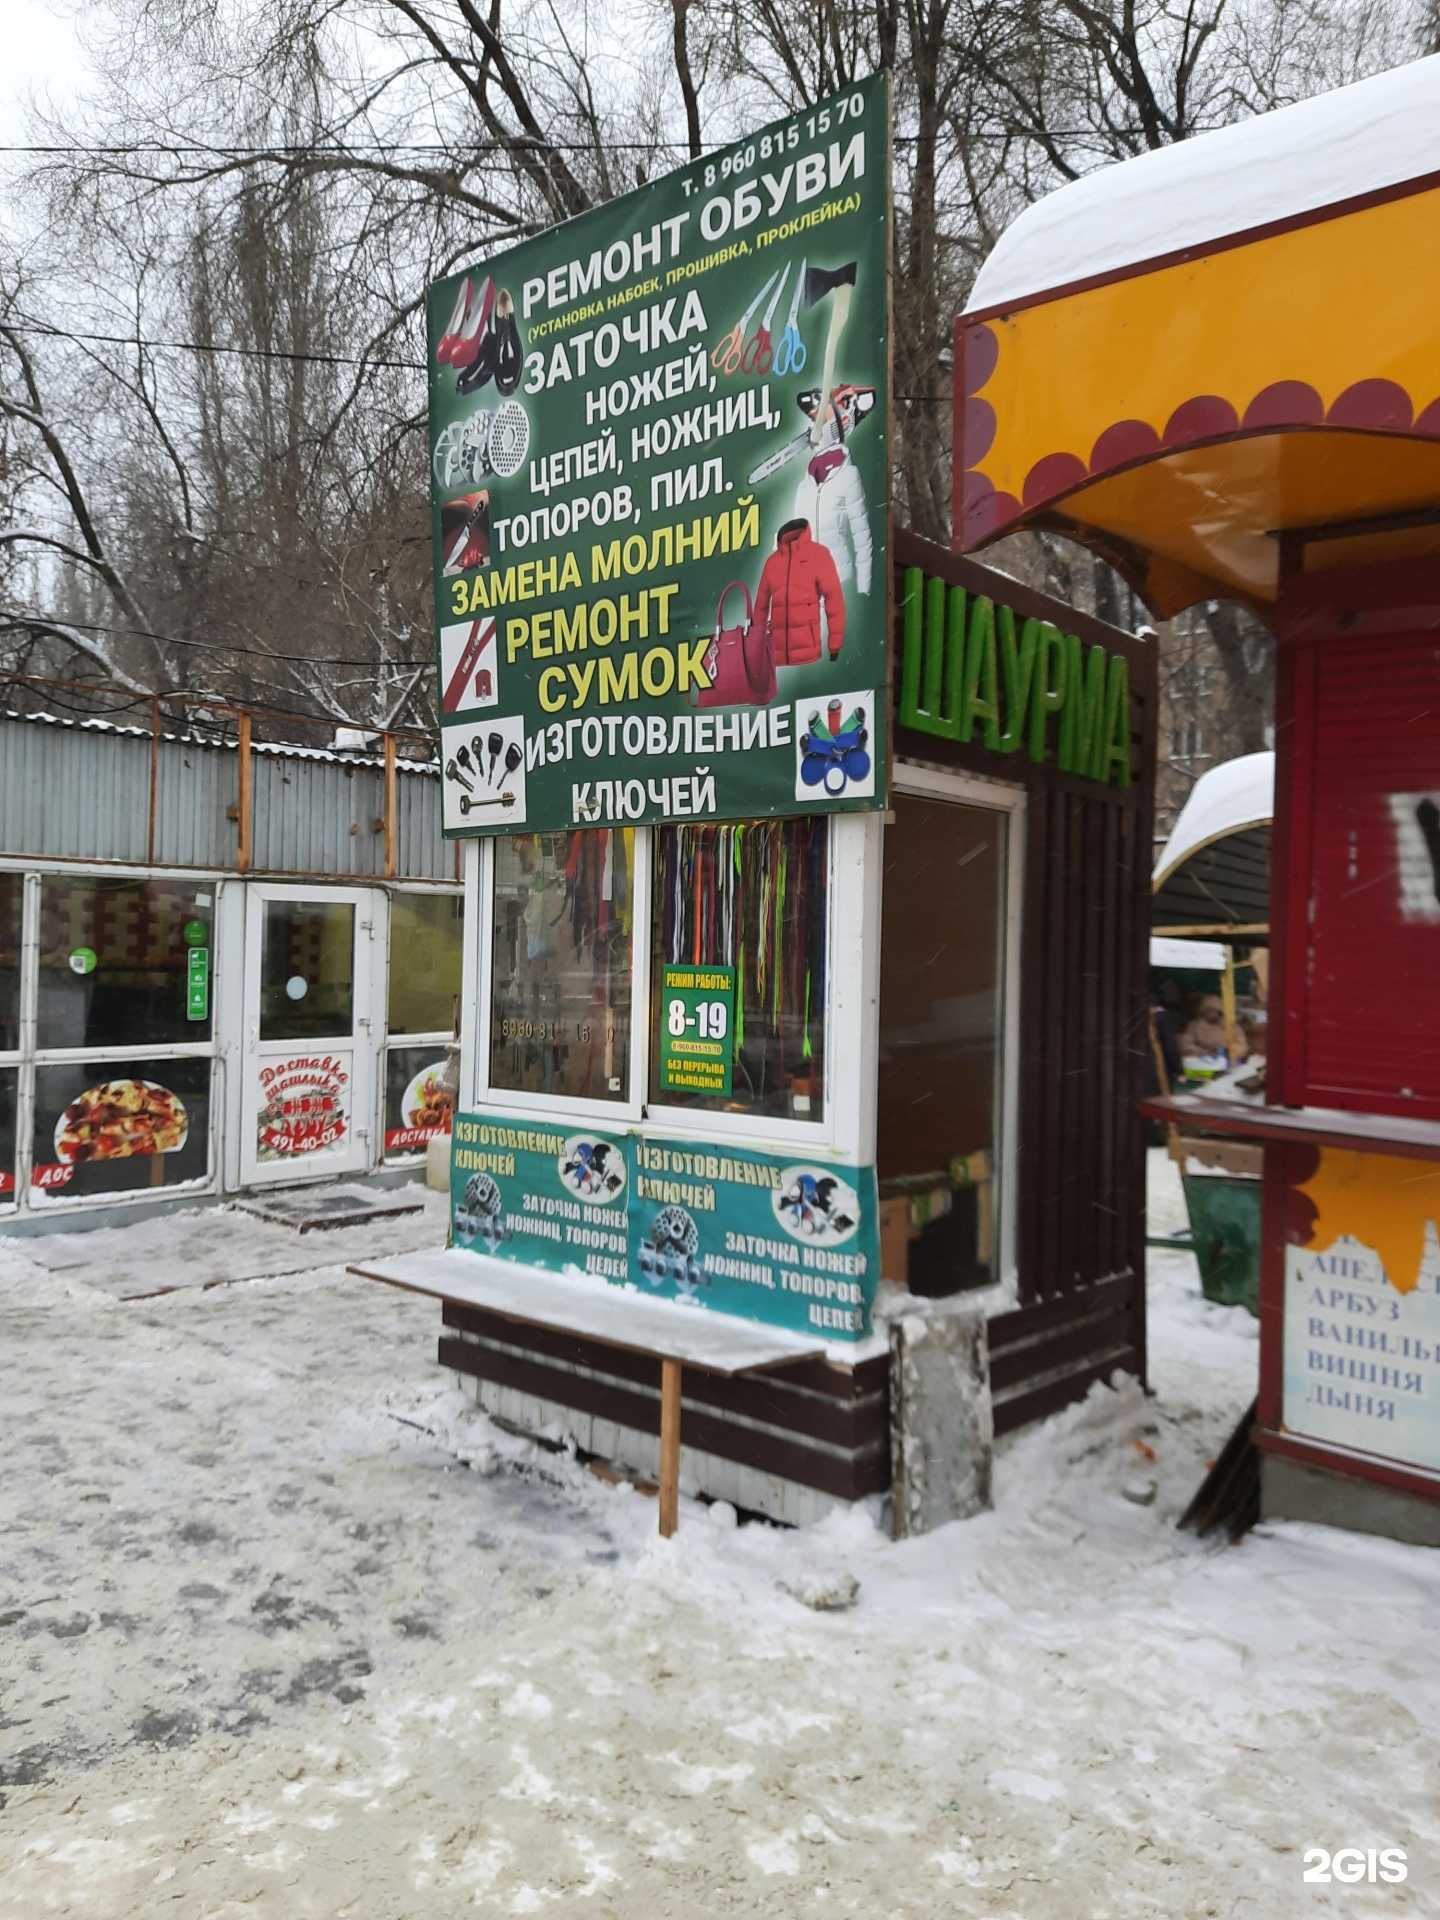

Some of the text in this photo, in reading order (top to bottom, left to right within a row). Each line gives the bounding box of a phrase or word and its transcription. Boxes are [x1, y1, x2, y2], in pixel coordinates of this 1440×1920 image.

[704, 164, 716, 187] 8
[721, 145, 756, 180] 960
[760, 124, 800, 159] 815
[806, 109, 831, 139] 15
[835, 92, 865, 125] 70
[521, 131, 866, 320] РЕМОНТ ОБУВИ
[527, 194, 862, 344] (УСТАНОВКА НАБОЕК, ПРОШИВКА, ПРОКЛЕЙКА)
[524, 289, 709, 395] ЗАТОЧКА
[584, 345, 718, 425] НОЖЕЙ,
[529, 384, 782, 496] ЦЕПЕЙ, НОЖНИЦ,
[493, 456, 734, 552] ТОПОРОВ, ПИЛ.
[451, 494, 760, 616] ЗАМЕНА МОЛНИЙ
[505, 583, 680, 664] РЕМОНТ
[538, 637, 713, 713] СУМОК
[899, 566, 1132, 790] ШАУРМА
[526, 704, 792, 773] ИЗГОТОВЛЕНИЕ
[571, 767, 717, 823] КЛЮЧЕЙ
[666, 972, 732, 990] РЕЖИМ РАБОТЫ:
[668, 999, 727, 1040] 8-19
[667, 1059, 682, 1070] БЕЗ
[455, 1149, 515, 1177] КЛЮЧЕЙ
[456, 1120, 567, 1157] ИЗГОТОВЛЕНИЕ
[636, 1144, 783, 1190] ИЗГОТОВЛЕНИЕ
[522, 1193, 581, 1220] ЗАТОЧКА
[704, 1254, 777, 1289] НОЖНИЦ,
[725, 1232, 801, 1265] ЗАТОЧКА
[1306, 1349, 1423, 1394] ВИШНЯ
[1306, 1383, 1396, 1422] ДЫНЯ
